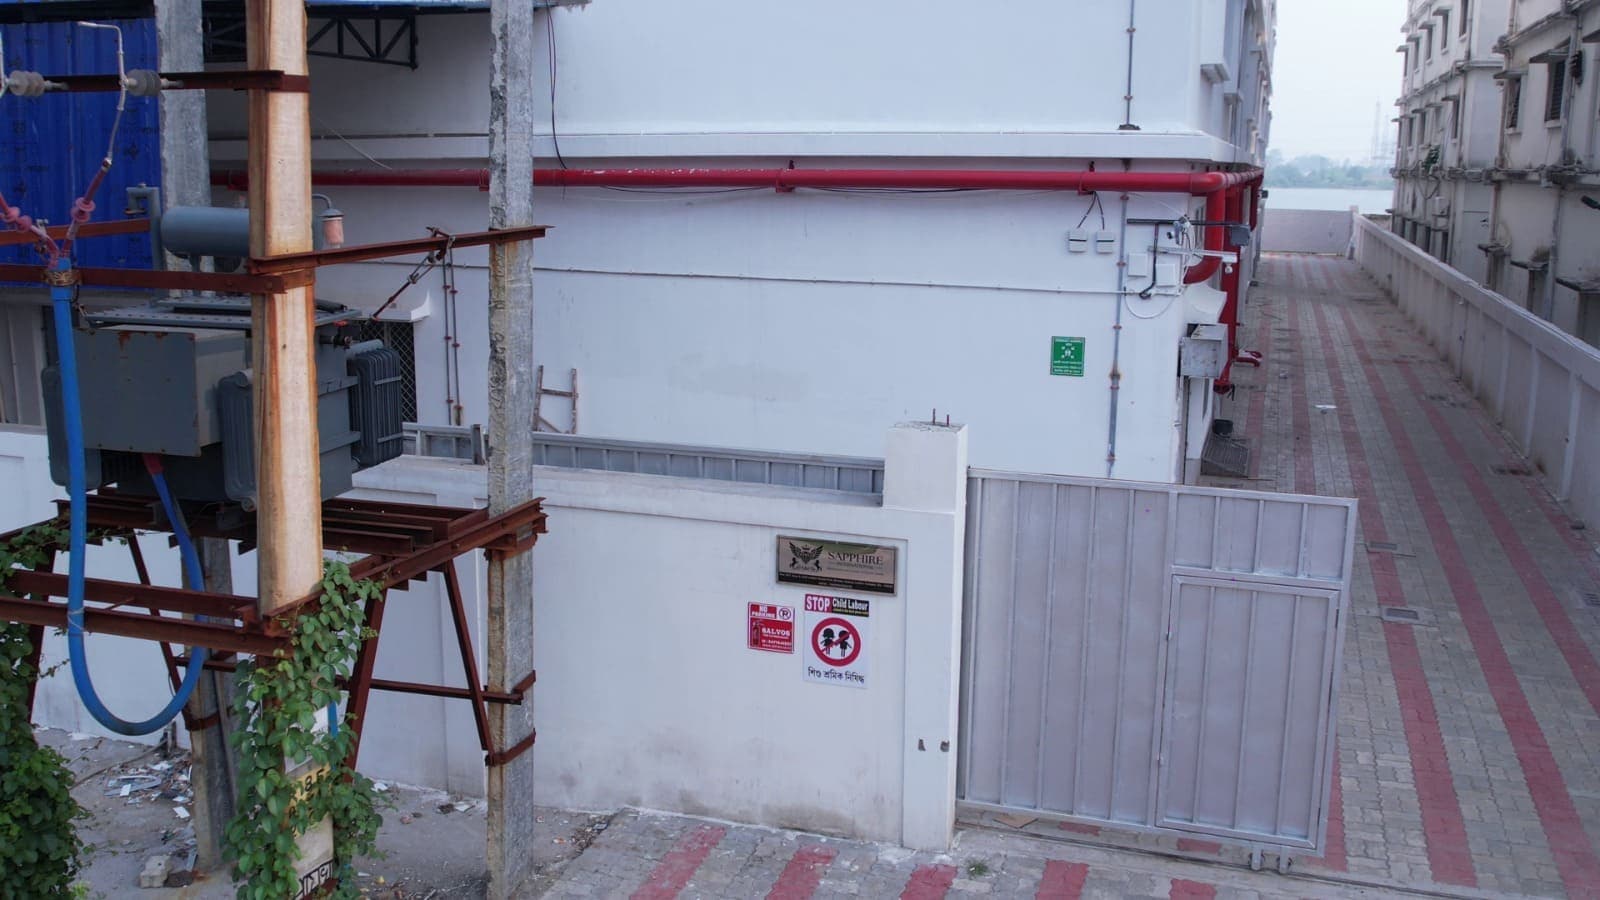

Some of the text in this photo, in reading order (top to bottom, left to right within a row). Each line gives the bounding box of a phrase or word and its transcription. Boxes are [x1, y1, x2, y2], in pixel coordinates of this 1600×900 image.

[828, 551, 884, 565] SAPPHIRE
[760, 605, 769, 613] NO
[807, 596, 830, 612] STOP
[833, 598, 847, 609] Child
[848, 600, 868, 611] Labour
[762, 628, 790, 639] SALVOS
[808, 666, 822, 678] শিশু
[823, 669, 844, 680] শ্রমিক
